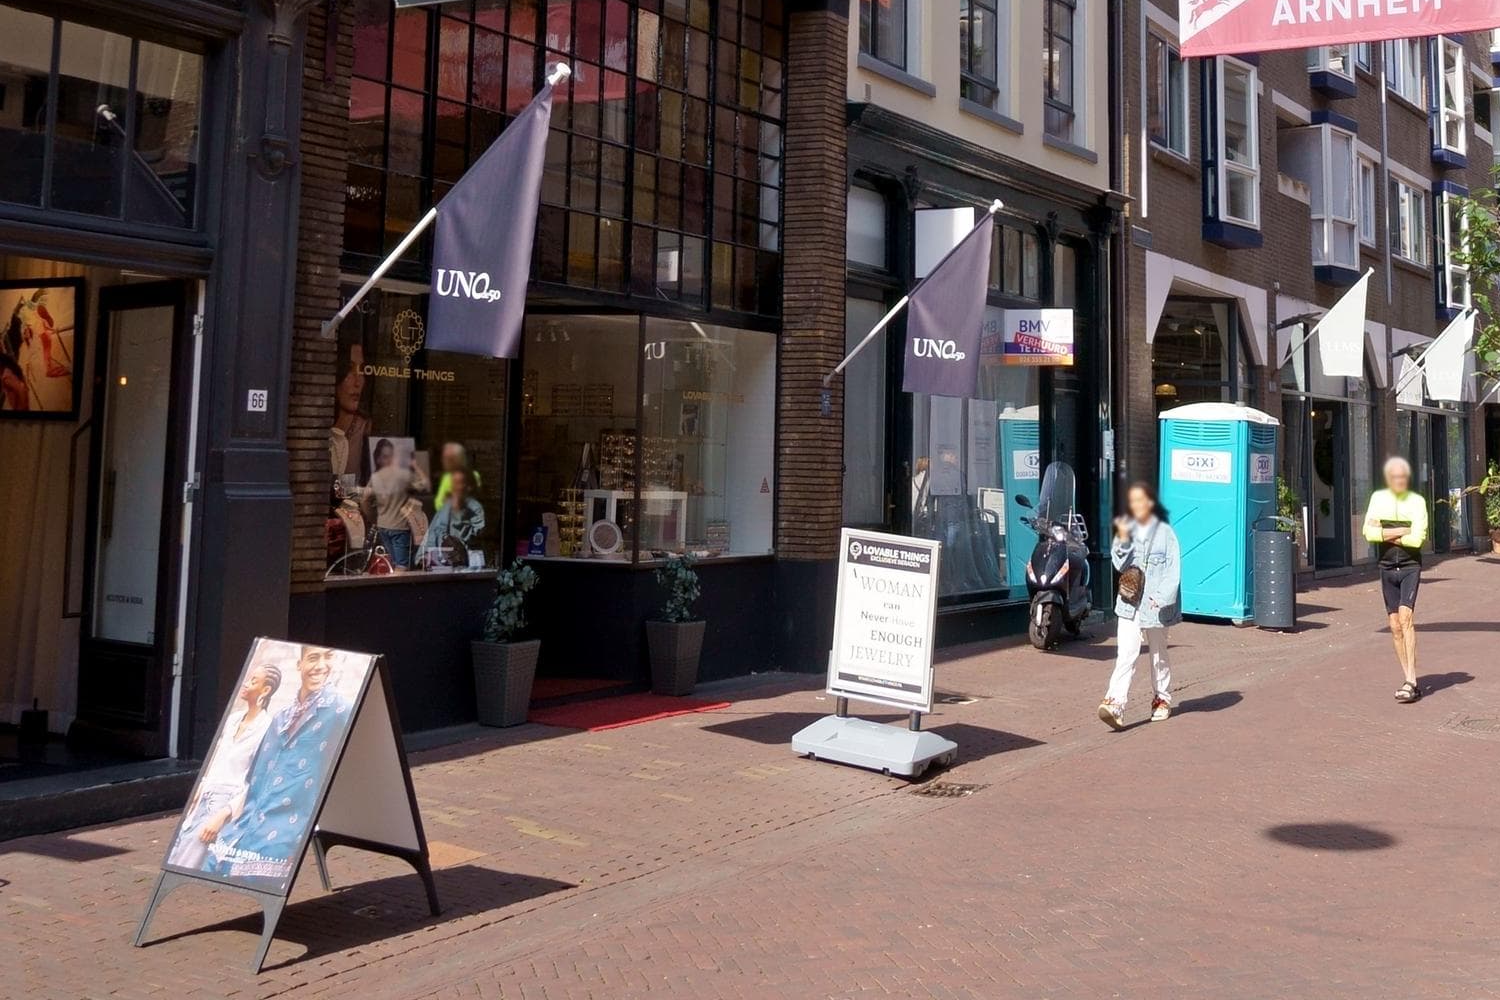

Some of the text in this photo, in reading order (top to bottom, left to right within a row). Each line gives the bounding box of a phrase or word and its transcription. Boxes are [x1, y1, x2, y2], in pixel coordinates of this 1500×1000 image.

[1019, 319, 1051, 333] BMV
[1017, 333, 1068, 355] VERHUURD
[356, 365, 455, 382] LOVABLE THINGS
[252, 393, 264, 409] 66
[863, 545, 899, 559] LOVABLE
[900, 550, 930, 564] THINGS
[861, 575, 924, 599] WOMAN
[883, 601, 901, 611] can
[860, 610, 889, 623] Never
[870, 629, 923, 649] ENOUGH
[850, 645, 915, 668] JEWELRY
